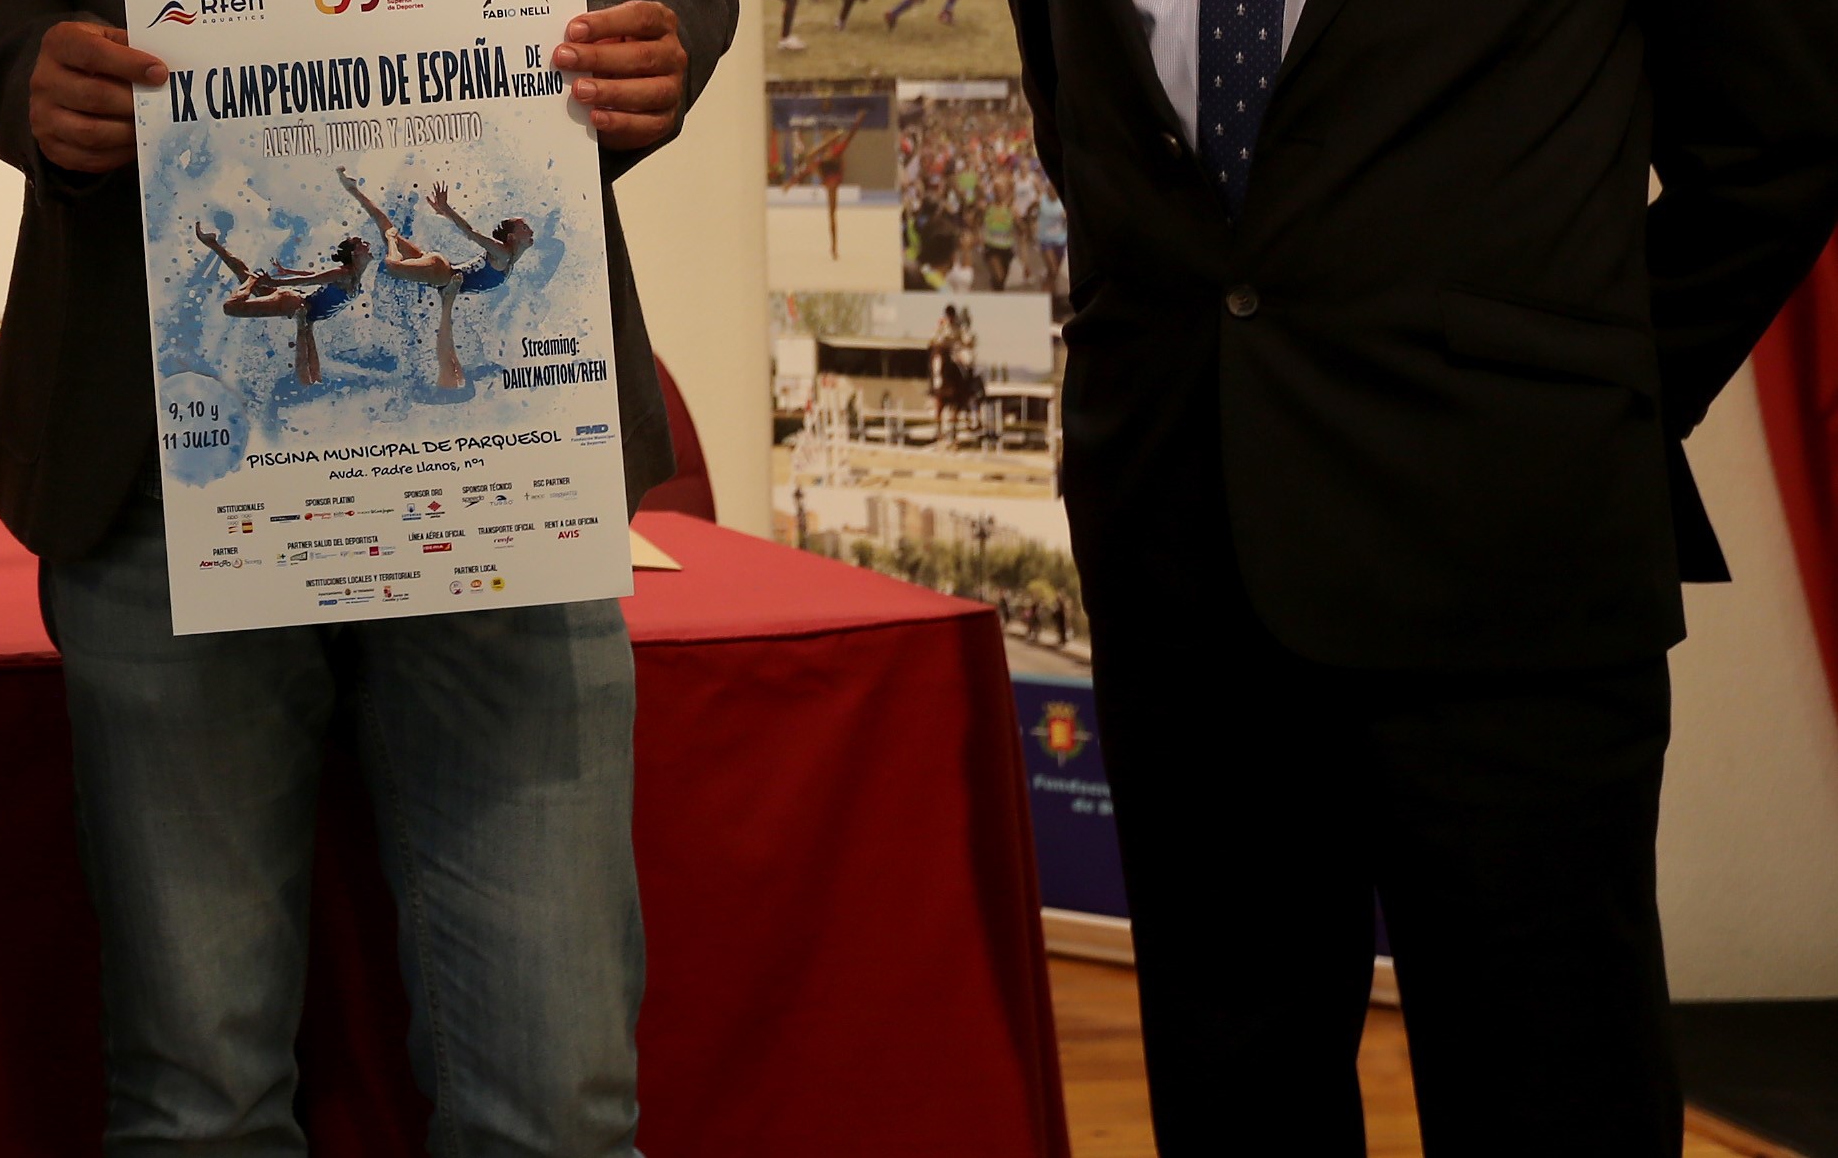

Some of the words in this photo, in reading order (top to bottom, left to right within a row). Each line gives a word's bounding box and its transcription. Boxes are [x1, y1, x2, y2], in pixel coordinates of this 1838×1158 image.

[396, 2, 424, 11] Deportes
[203, 14, 265, 24] AQUATICS
[483, 8, 516, 20] FABIO
[520, 6, 550, 17] NELLI
[169, 70, 198, 123] IX
[205, 56, 371, 120] CAMPEONATO
[378, 53, 411, 106] DE
[417, 37, 511, 104] ESPAÑA
[525, 44, 542, 69] DE
[511, 70, 563, 98] VERANO
[263, 118, 322, 158] ALEVÍN,
[325, 120, 384, 158] JUNIOR
[386, 117, 398, 148] Y
[404, 111, 483, 147] ABSOLUTO
[522, 334, 580, 358] Streaming:
[503, 360, 608, 390] DAILYMOTION/RFEN
[168, 402, 183, 422] 9,
[187, 401, 205, 418] 10
[211, 404, 220, 421] y
[576, 424, 609, 435] FMD
[162, 433, 177, 450] 11
[182, 429, 230, 448] JULIO
[247, 450, 320, 468] PISCINA
[323, 442, 421, 461] MUNICIPAL
[423, 440, 452, 453] DE
[455, 430, 562, 452] PARQUESOL
[329, 468, 368, 480] Avda.
[371, 464, 413, 477] Padre
[416, 460, 461, 473] Llanos,
[533, 479, 544, 488] RSC
[545, 477, 570, 487] PARTNER
[404, 489, 430, 499] SPONSOR
[431, 488, 443, 497] ORO
[462, 485, 488, 494] SPONSOR
[305, 498, 332, 507] SPONSOR
[333, 495, 355, 505] PLATINO
[217, 502, 265, 514] INSTITUCIONALES
[478, 525, 513, 535] TRANSPORTE
[514, 523, 535, 532] OFICIAL
[545, 521, 558, 529] RENT
[565, 518, 576, 527] CAR
[445, 529, 466, 538] OFICIAL
[557, 529, 580, 539] AVIS
[287, 540, 312, 550] PARTNER
[313, 539, 332, 548] SALUD
[333, 538, 344, 546] DEL
[345, 535, 378, 545] DEPORTISTA
[213, 547, 238, 556] PARTNER
[454, 565, 479, 575] PARTNER
[480, 564, 498, 573] LOCAL
[306, 577, 346, 588] INSTITUCIONES
[348, 575, 372, 584] LOCALES
[379, 571, 421, 581] TERRITORIALES
